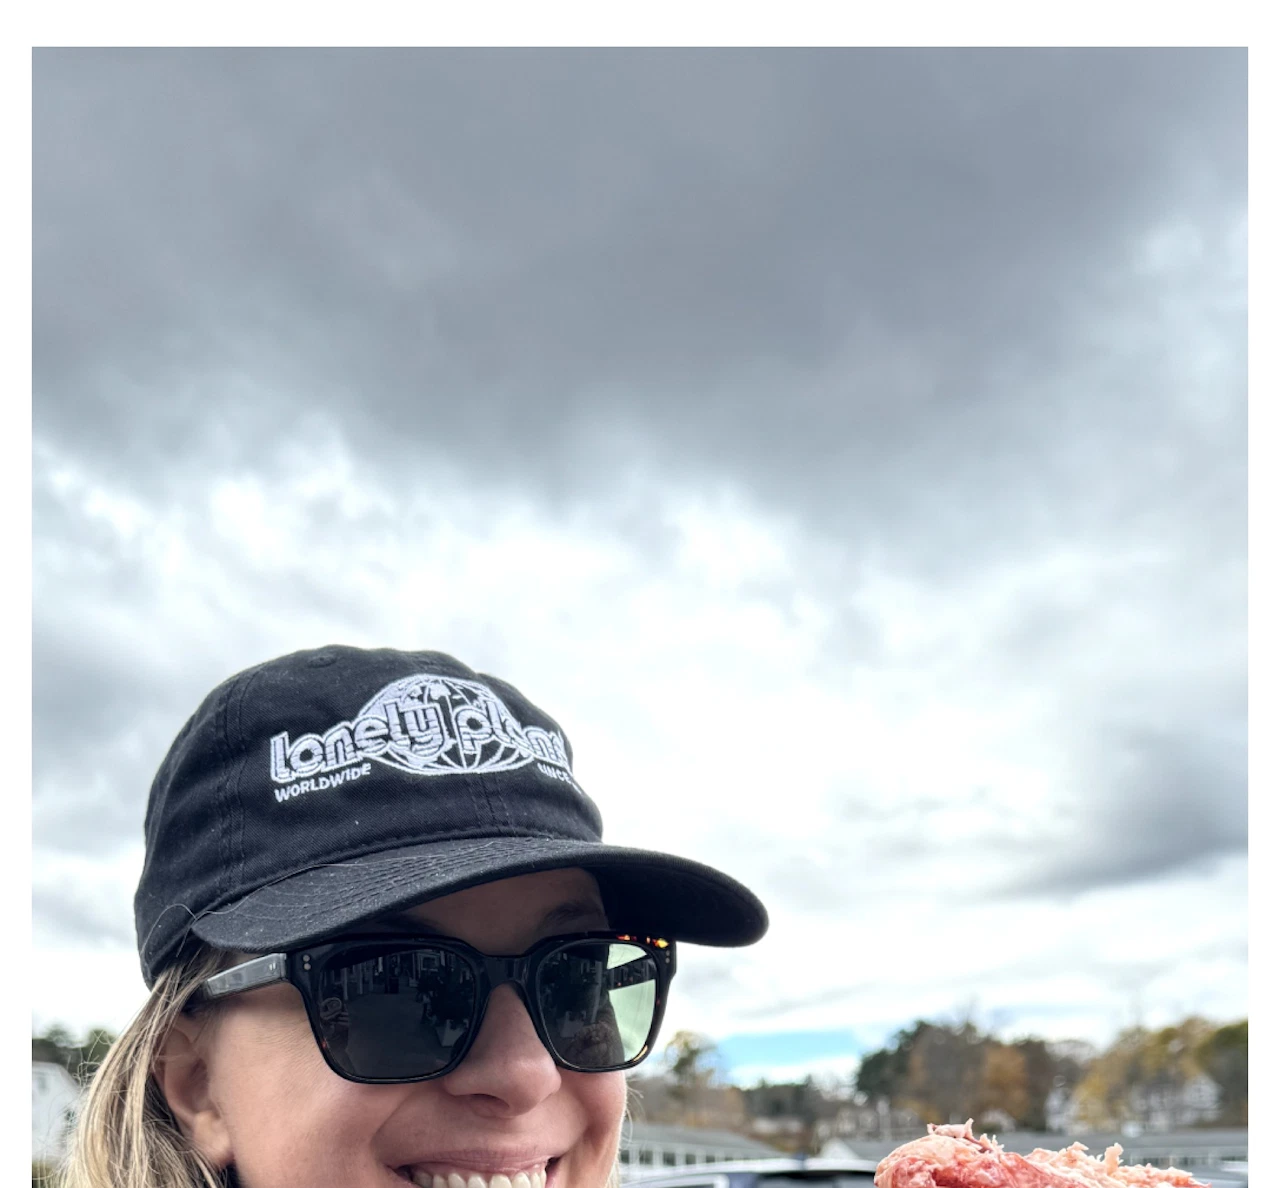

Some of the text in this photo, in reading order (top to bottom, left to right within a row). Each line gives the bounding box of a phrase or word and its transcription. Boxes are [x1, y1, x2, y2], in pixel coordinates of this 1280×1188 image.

[270, 699, 568, 784] lonely plan
[274, 762, 372, 803] WORLDWIDE
